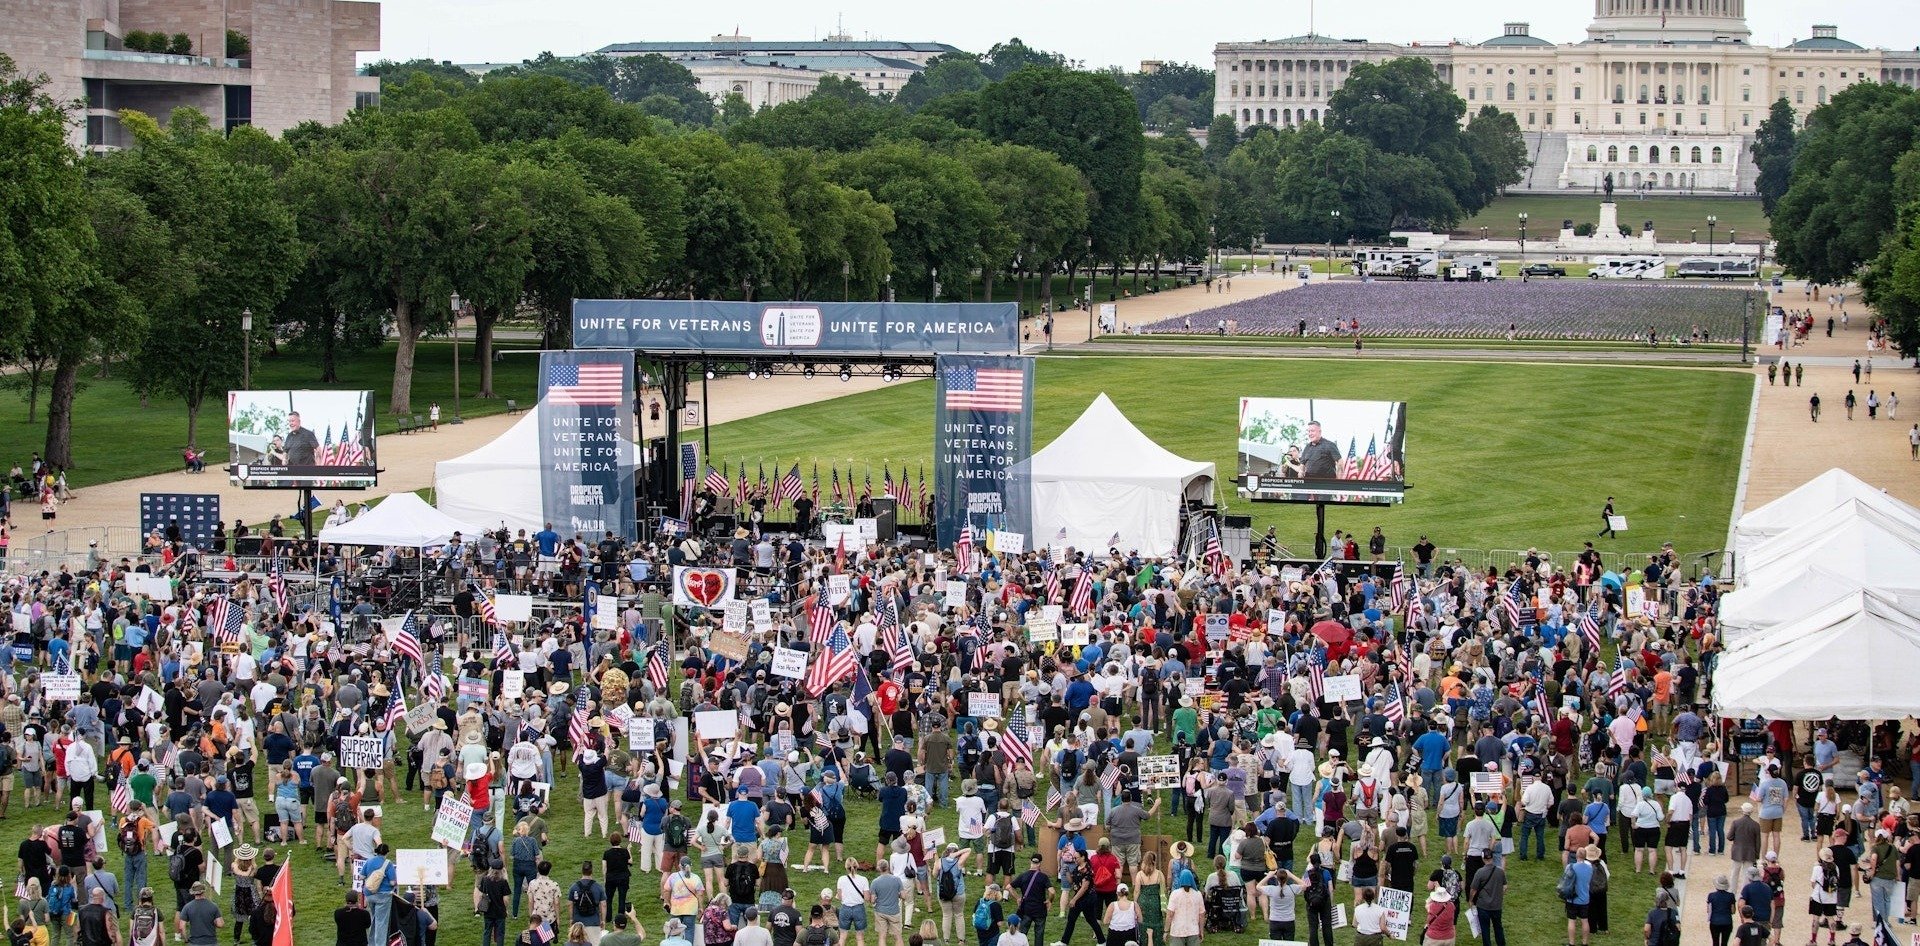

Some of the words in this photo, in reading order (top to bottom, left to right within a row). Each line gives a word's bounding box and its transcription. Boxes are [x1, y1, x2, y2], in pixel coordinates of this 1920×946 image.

[580, 318, 626, 330] UNITE
[632, 318, 661, 330] FOR
[669, 318, 752, 332] VETERANS
[830, 321, 878, 333] UNITE
[886, 322, 915, 333] FOR
[923, 322, 994, 334] AMERICA
[553, 418, 591, 427] UNITE
[597, 417, 622, 427] FOR
[944, 424, 983, 433] UNITE
[990, 425, 1014, 435] FOR
[552, 432, 625, 442] VETERANS.
[945, 439, 1018, 450] VETERANS.
[554, 448, 591, 456] UNITE
[598, 447, 622, 456] FOR
[944, 454, 984, 464] UNITE
[990, 456, 1014, 466] FOR
[554, 462, 615, 472] AMERICA.
[956, 470, 1018, 481] AMERICA.
[570, 485, 603, 495] DROPKICK
[570, 495, 604, 506] MURPHYS
[968, 492, 1002, 502] DROPKICK
[968, 502, 1002, 513] MURPHYS
[830, 586, 847, 594] VETS
[726, 621, 744, 629] TRUMP
[342, 739, 381, 753] SUPPORT
[341, 752, 381, 768] VETERANS
[444, 797, 459, 809] THEY
[459, 804, 471, 816] CUT
[441, 805, 454, 815] VET
[455, 810, 469, 823] CARE
[449, 817, 467, 830] FUND
[1382, 889, 1410, 902] VETERANS
[1379, 898, 1388, 908] ARE
[1390, 900, 1409, 912] HEROES
[1387, 910, 1399, 918] NOT
[1398, 922, 1406, 930] and
